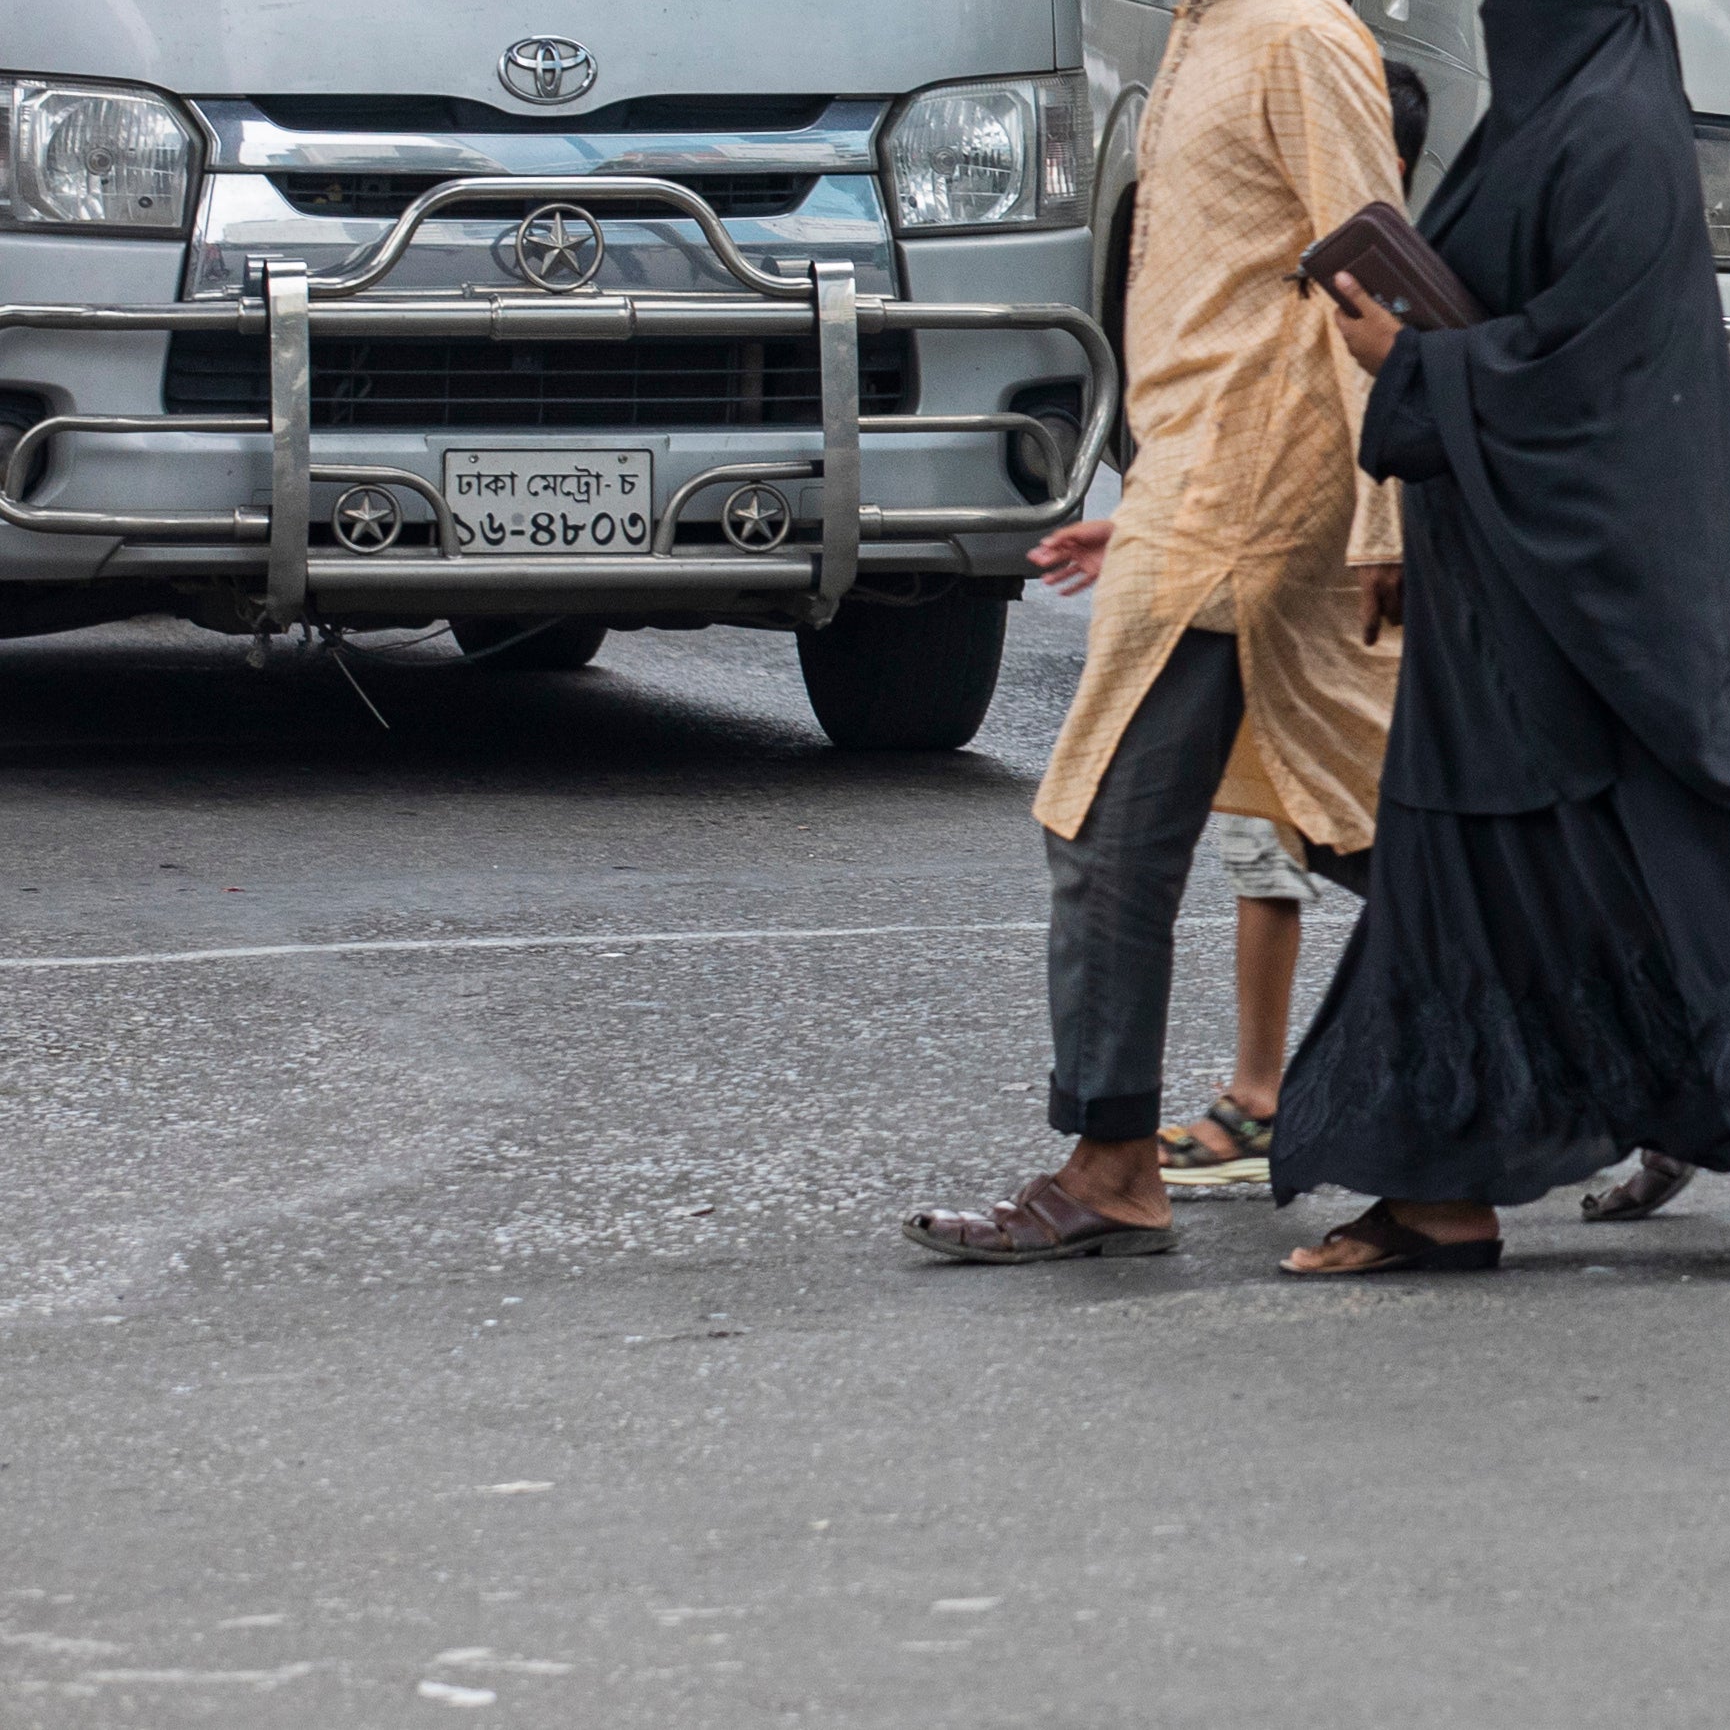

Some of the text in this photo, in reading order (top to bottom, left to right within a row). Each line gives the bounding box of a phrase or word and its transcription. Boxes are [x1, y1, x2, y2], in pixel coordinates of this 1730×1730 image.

[456, 471, 519, 497] ঢাকা
[618, 473, 639, 496] চ
[452, 511, 648, 546] ১৬-৪৮০৩
